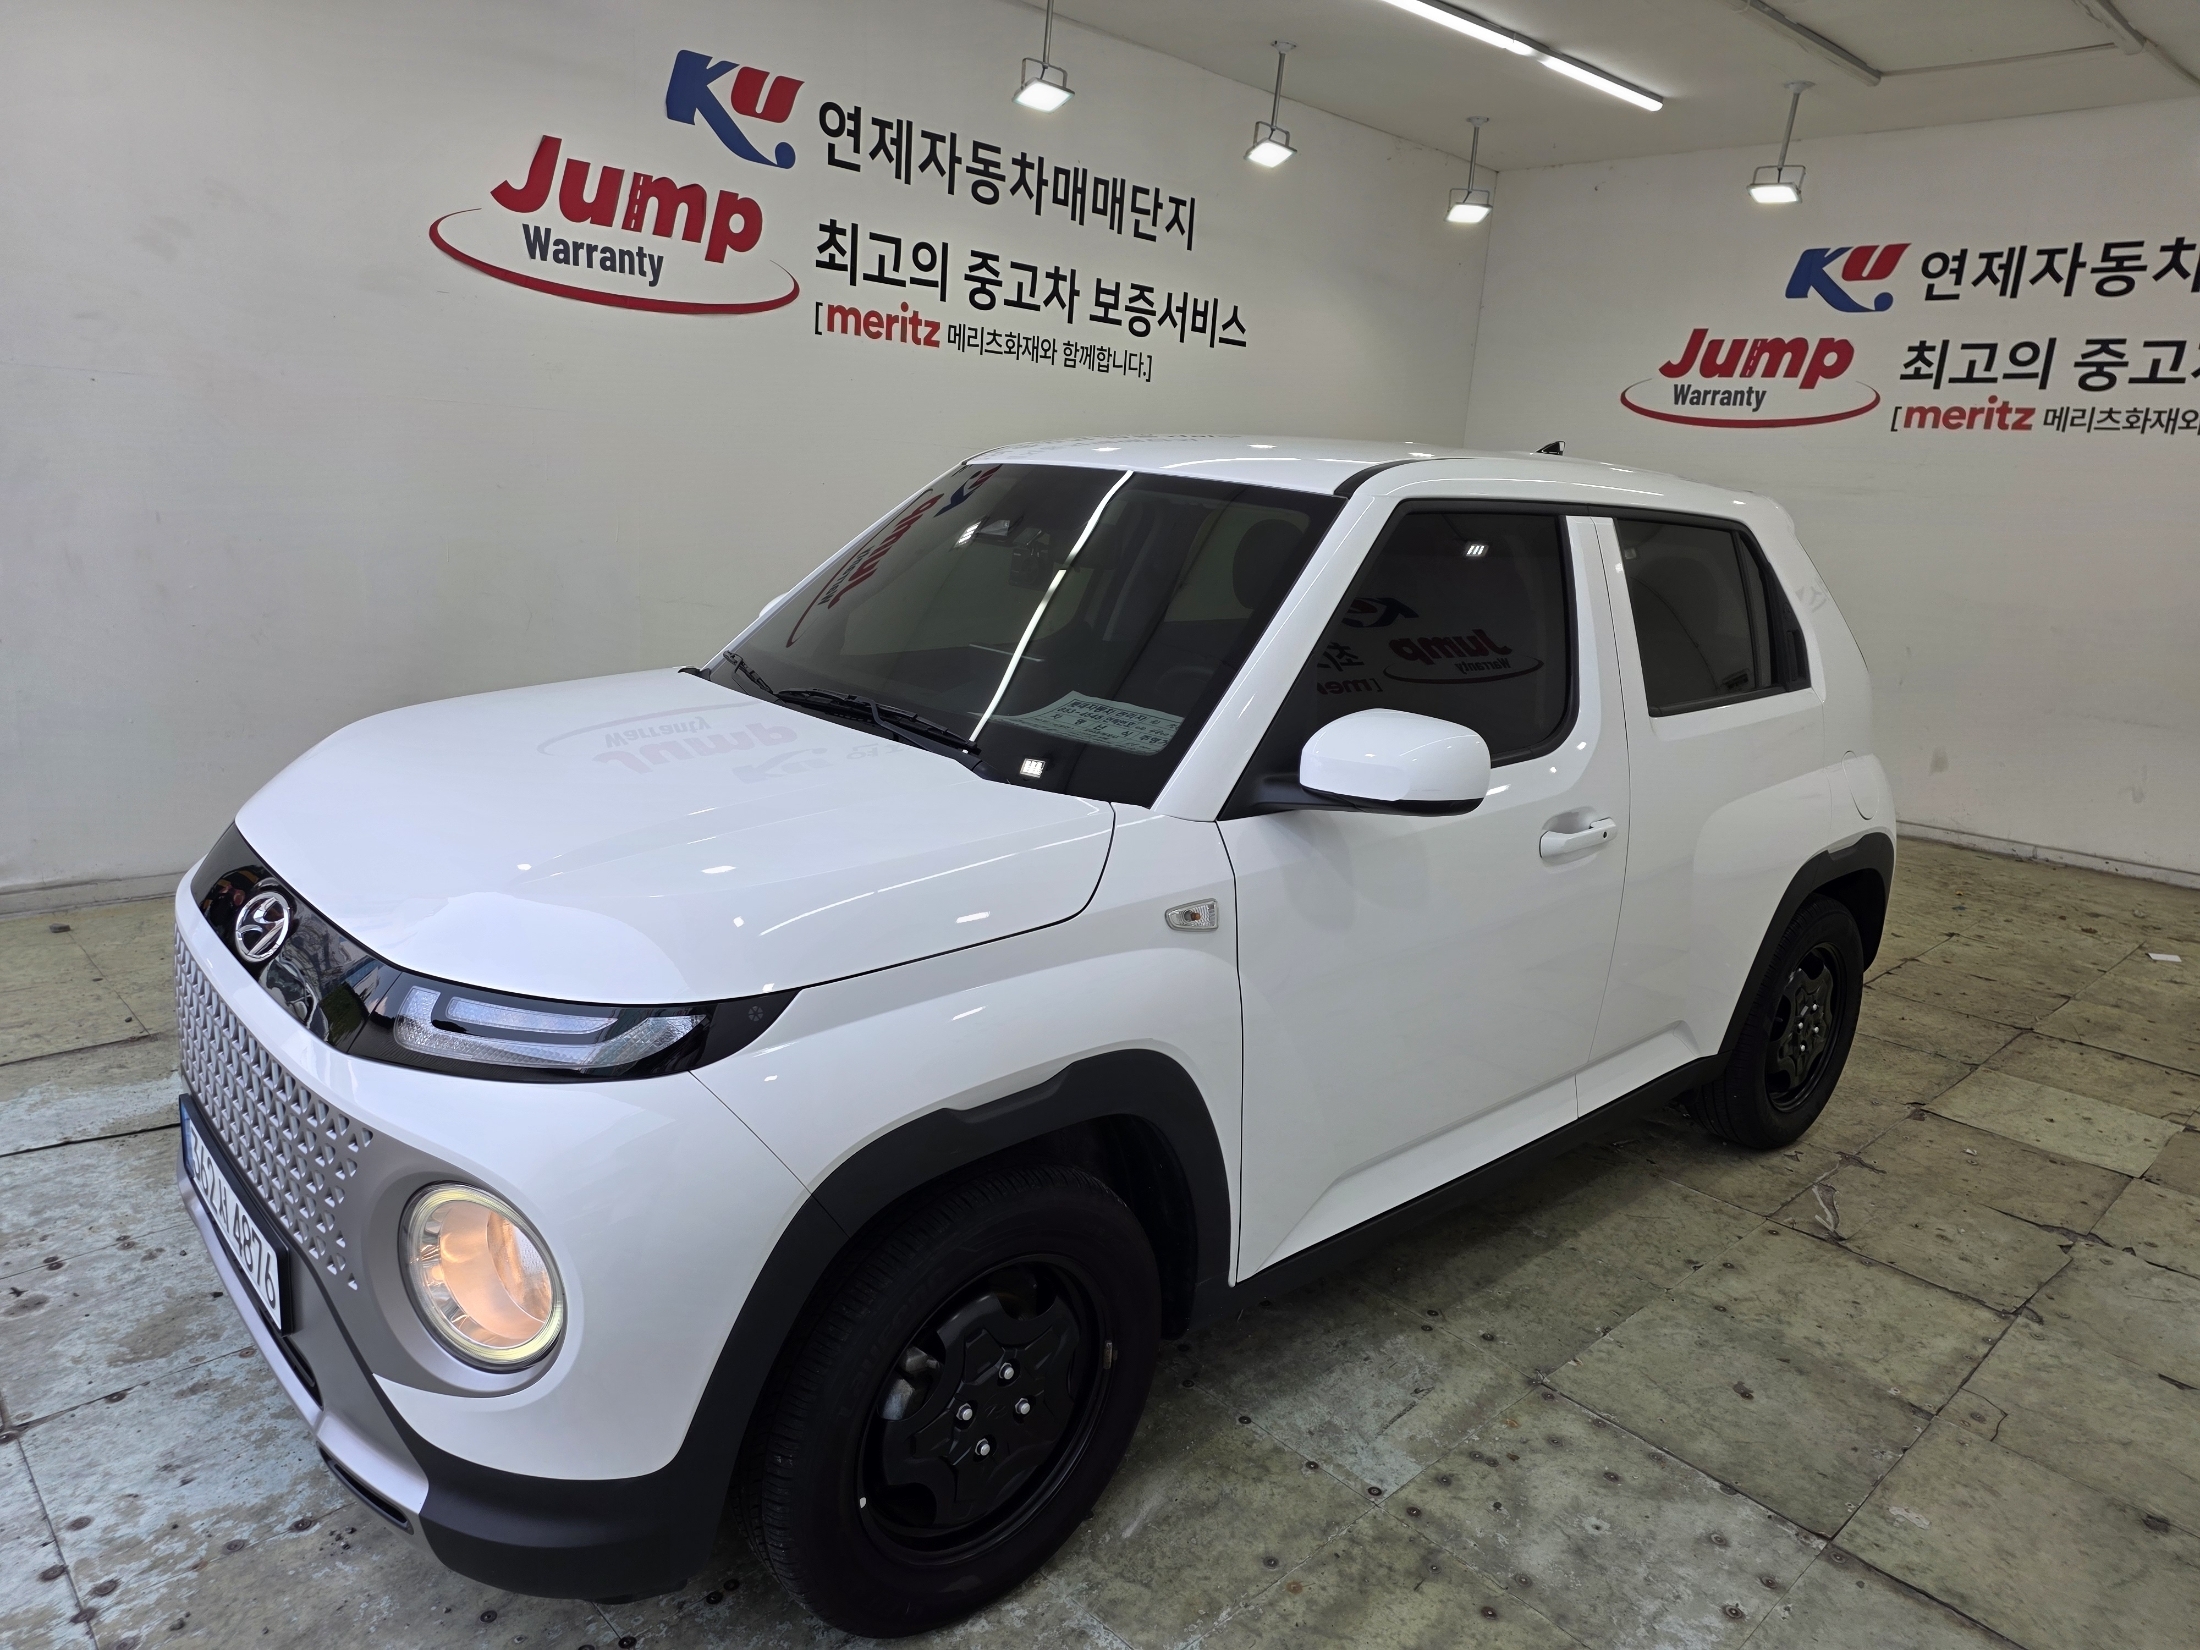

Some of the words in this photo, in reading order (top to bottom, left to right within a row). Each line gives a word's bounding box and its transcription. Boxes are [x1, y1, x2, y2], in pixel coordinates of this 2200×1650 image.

[490, 135, 763, 264] Jump
[818, 100, 1197, 252] 연제자동차매매단지
[523, 224, 664, 288] Warranty
[815, 217, 949, 303] 최고의
[963, 249, 1081, 325] 중고차
[1090, 277, 1248, 350] 보증서비스
[947, 323, 1058, 367] 메리츠화재와
[1658, 328, 1855, 390] Jump
[1899, 337, 2057, 391] 최고의
[2073, 338, 2200, 392] 중고
[1673, 384, 1768, 413] Warranty
[190, 1126, 230, 1234] 362서
[232, 1202, 276, 1310] 4876
